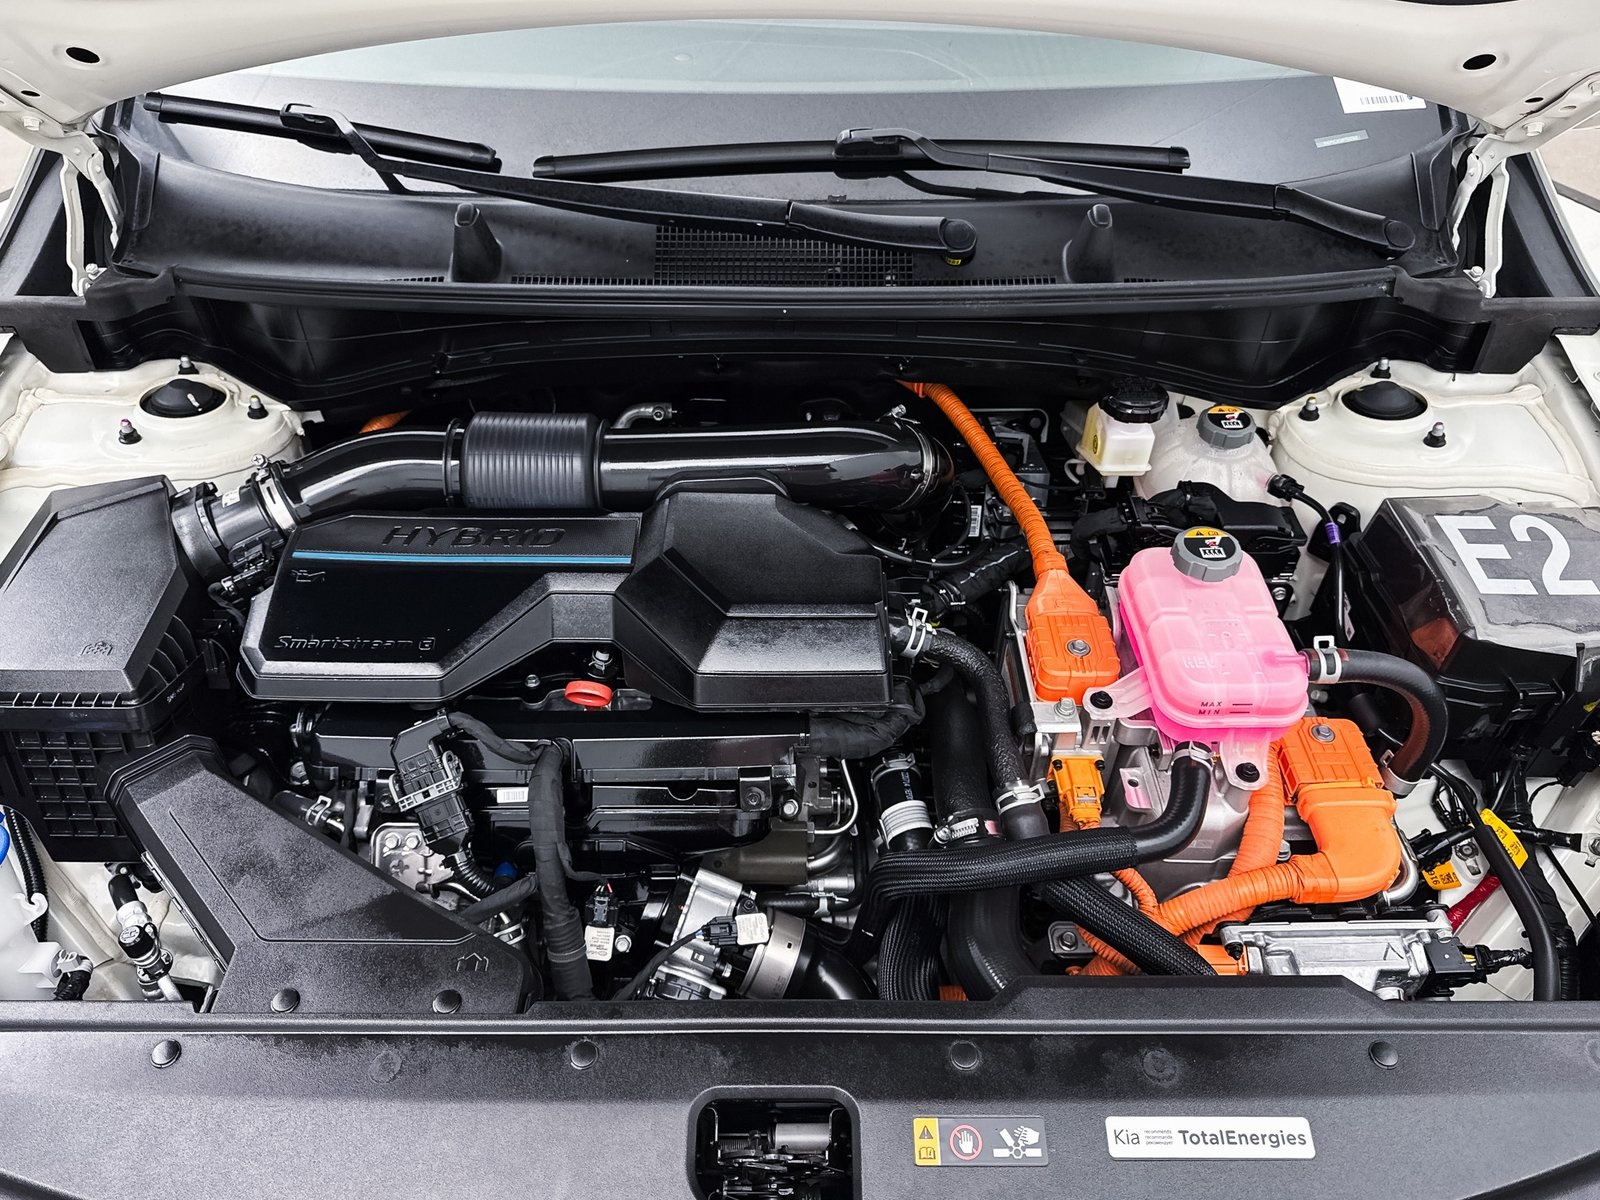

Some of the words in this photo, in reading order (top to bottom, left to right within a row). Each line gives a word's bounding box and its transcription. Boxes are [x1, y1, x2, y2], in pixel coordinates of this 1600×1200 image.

[381, 525, 567, 548] HYBRID
[1433, 514, 1600, 596] E2
[274, 634, 414, 649] Smartstream
[1113, 1128, 1141, 1145] Kia
[1178, 1129, 1307, 1148] TotalEnergies
